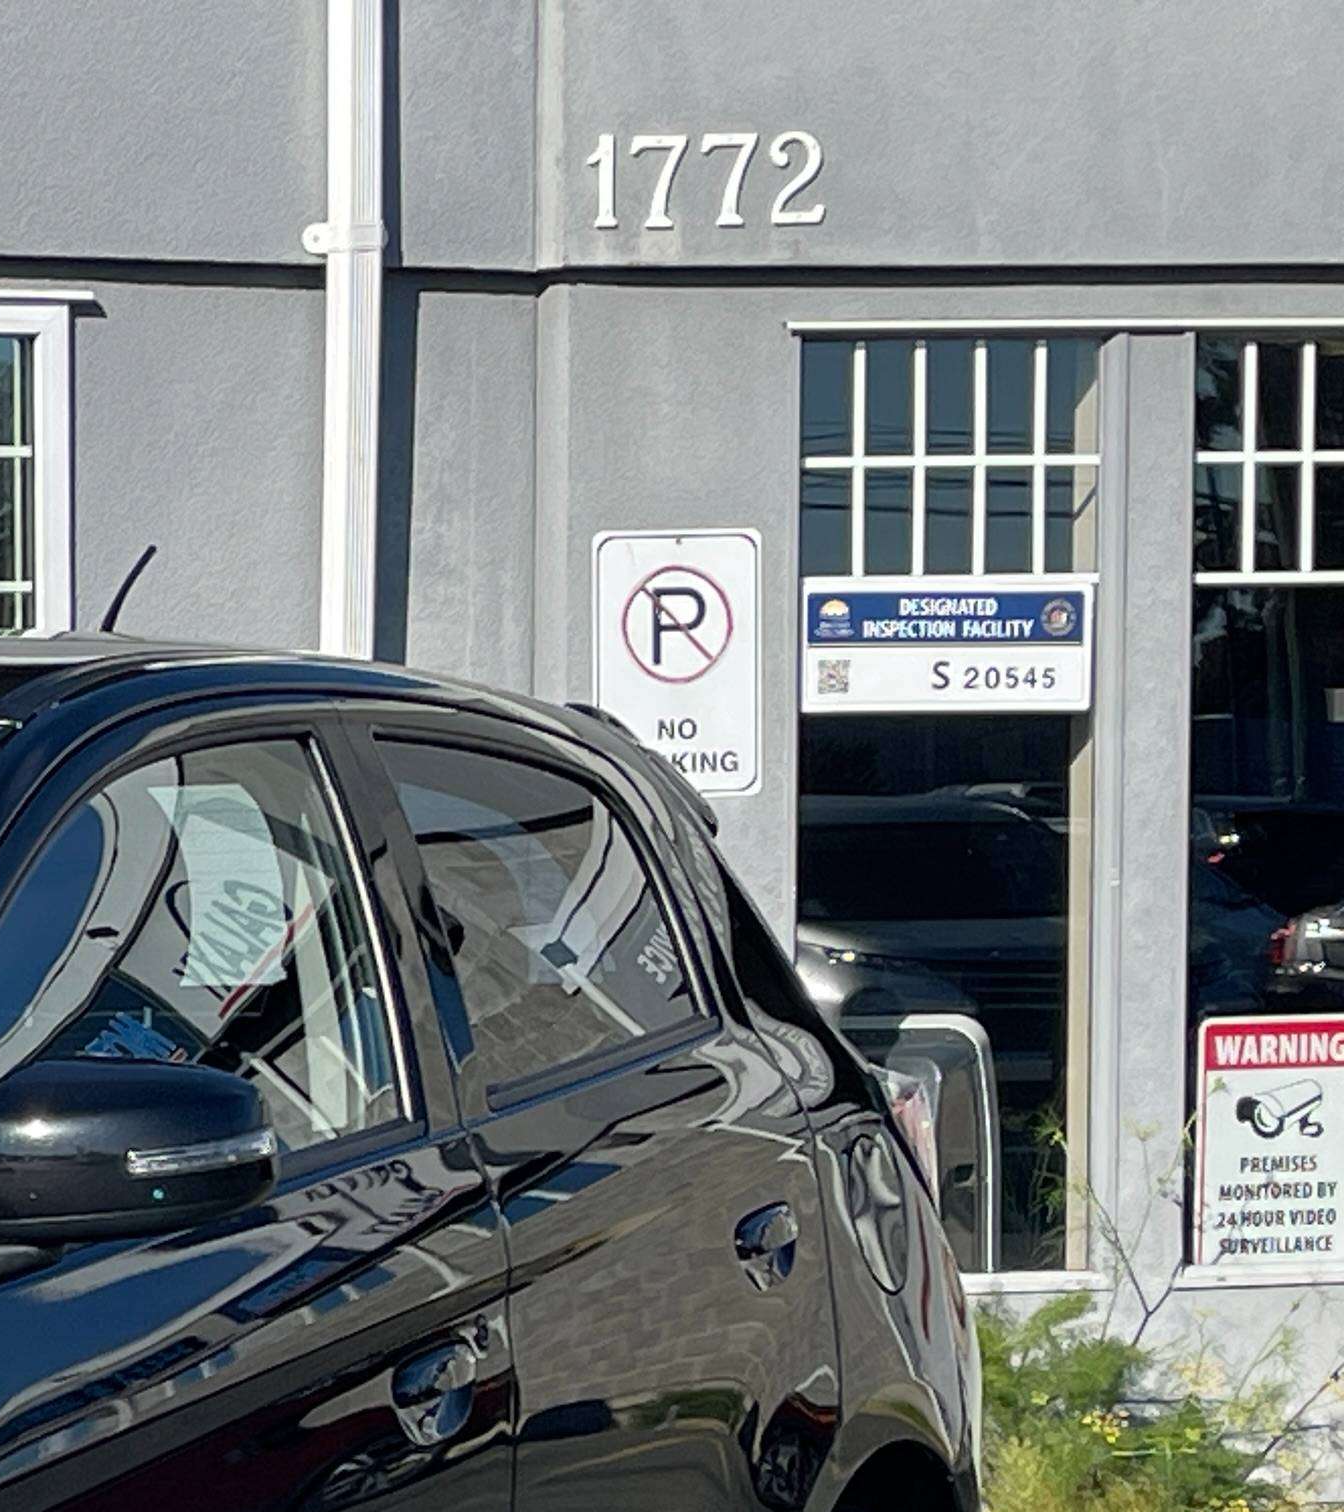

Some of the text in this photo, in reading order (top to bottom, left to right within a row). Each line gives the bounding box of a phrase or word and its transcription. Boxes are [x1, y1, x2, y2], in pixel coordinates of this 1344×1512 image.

[586, 130, 826, 230] 1772
[898, 597, 999, 617] DESIGNATED
[652, 586, 707, 666] P
[862, 619, 956, 639] INSPECTION
[961, 618, 1035, 639] FACILITY
[931, 660, 1057, 690] S 20545
[657, 717, 698, 740] NO
[662, 750, 740, 773] KING
[1214, 1031, 1344, 1067] WARNING
[1240, 1154, 1318, 1174] PREMISES
[1218, 1181, 1337, 1201] MONITORED BY
[1214, 1207, 1337, 1229] 24 HOUR VIDEO
[1218, 1234, 1333, 1254] SURVEILLANCE
